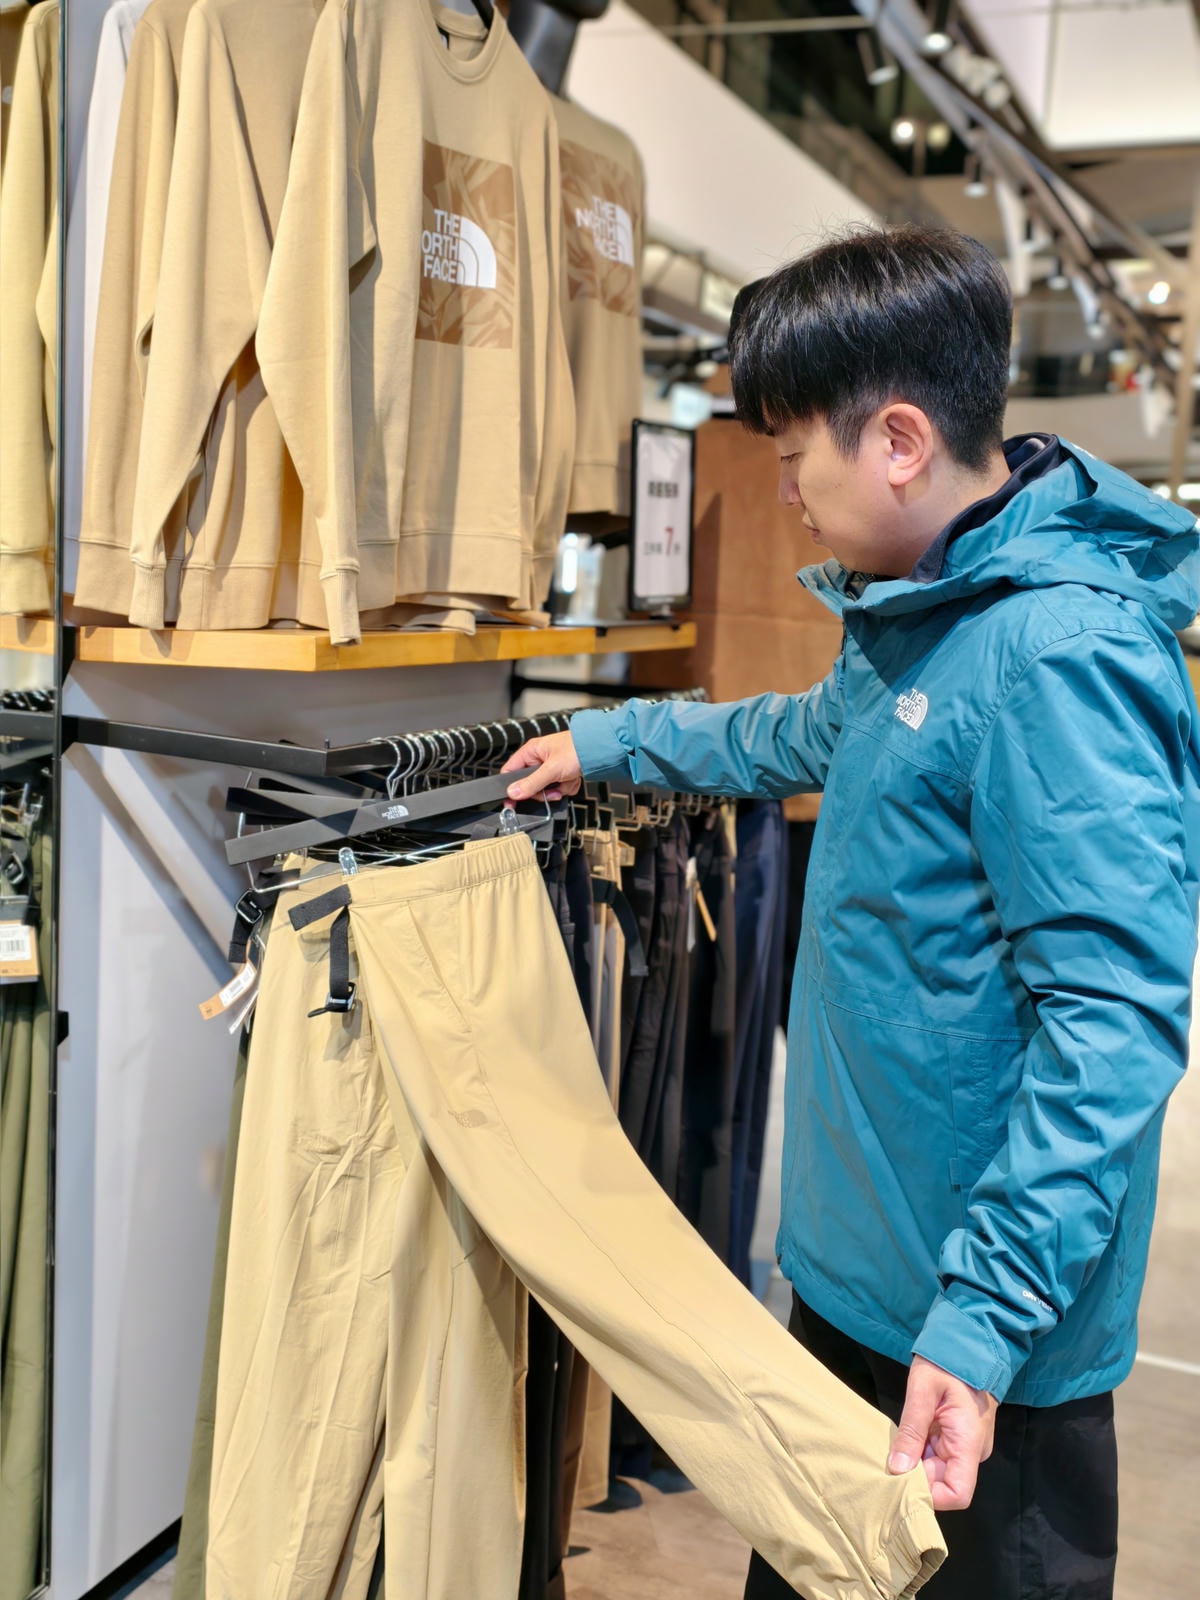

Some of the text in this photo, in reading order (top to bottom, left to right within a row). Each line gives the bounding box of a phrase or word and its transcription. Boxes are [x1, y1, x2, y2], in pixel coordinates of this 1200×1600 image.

[433, 208, 460, 237] THE
[421, 229, 459, 261] ORTH
[423, 254, 458, 284] FACE
[895, 693, 918, 715] NORTH
[910, 688, 924, 706] THE
